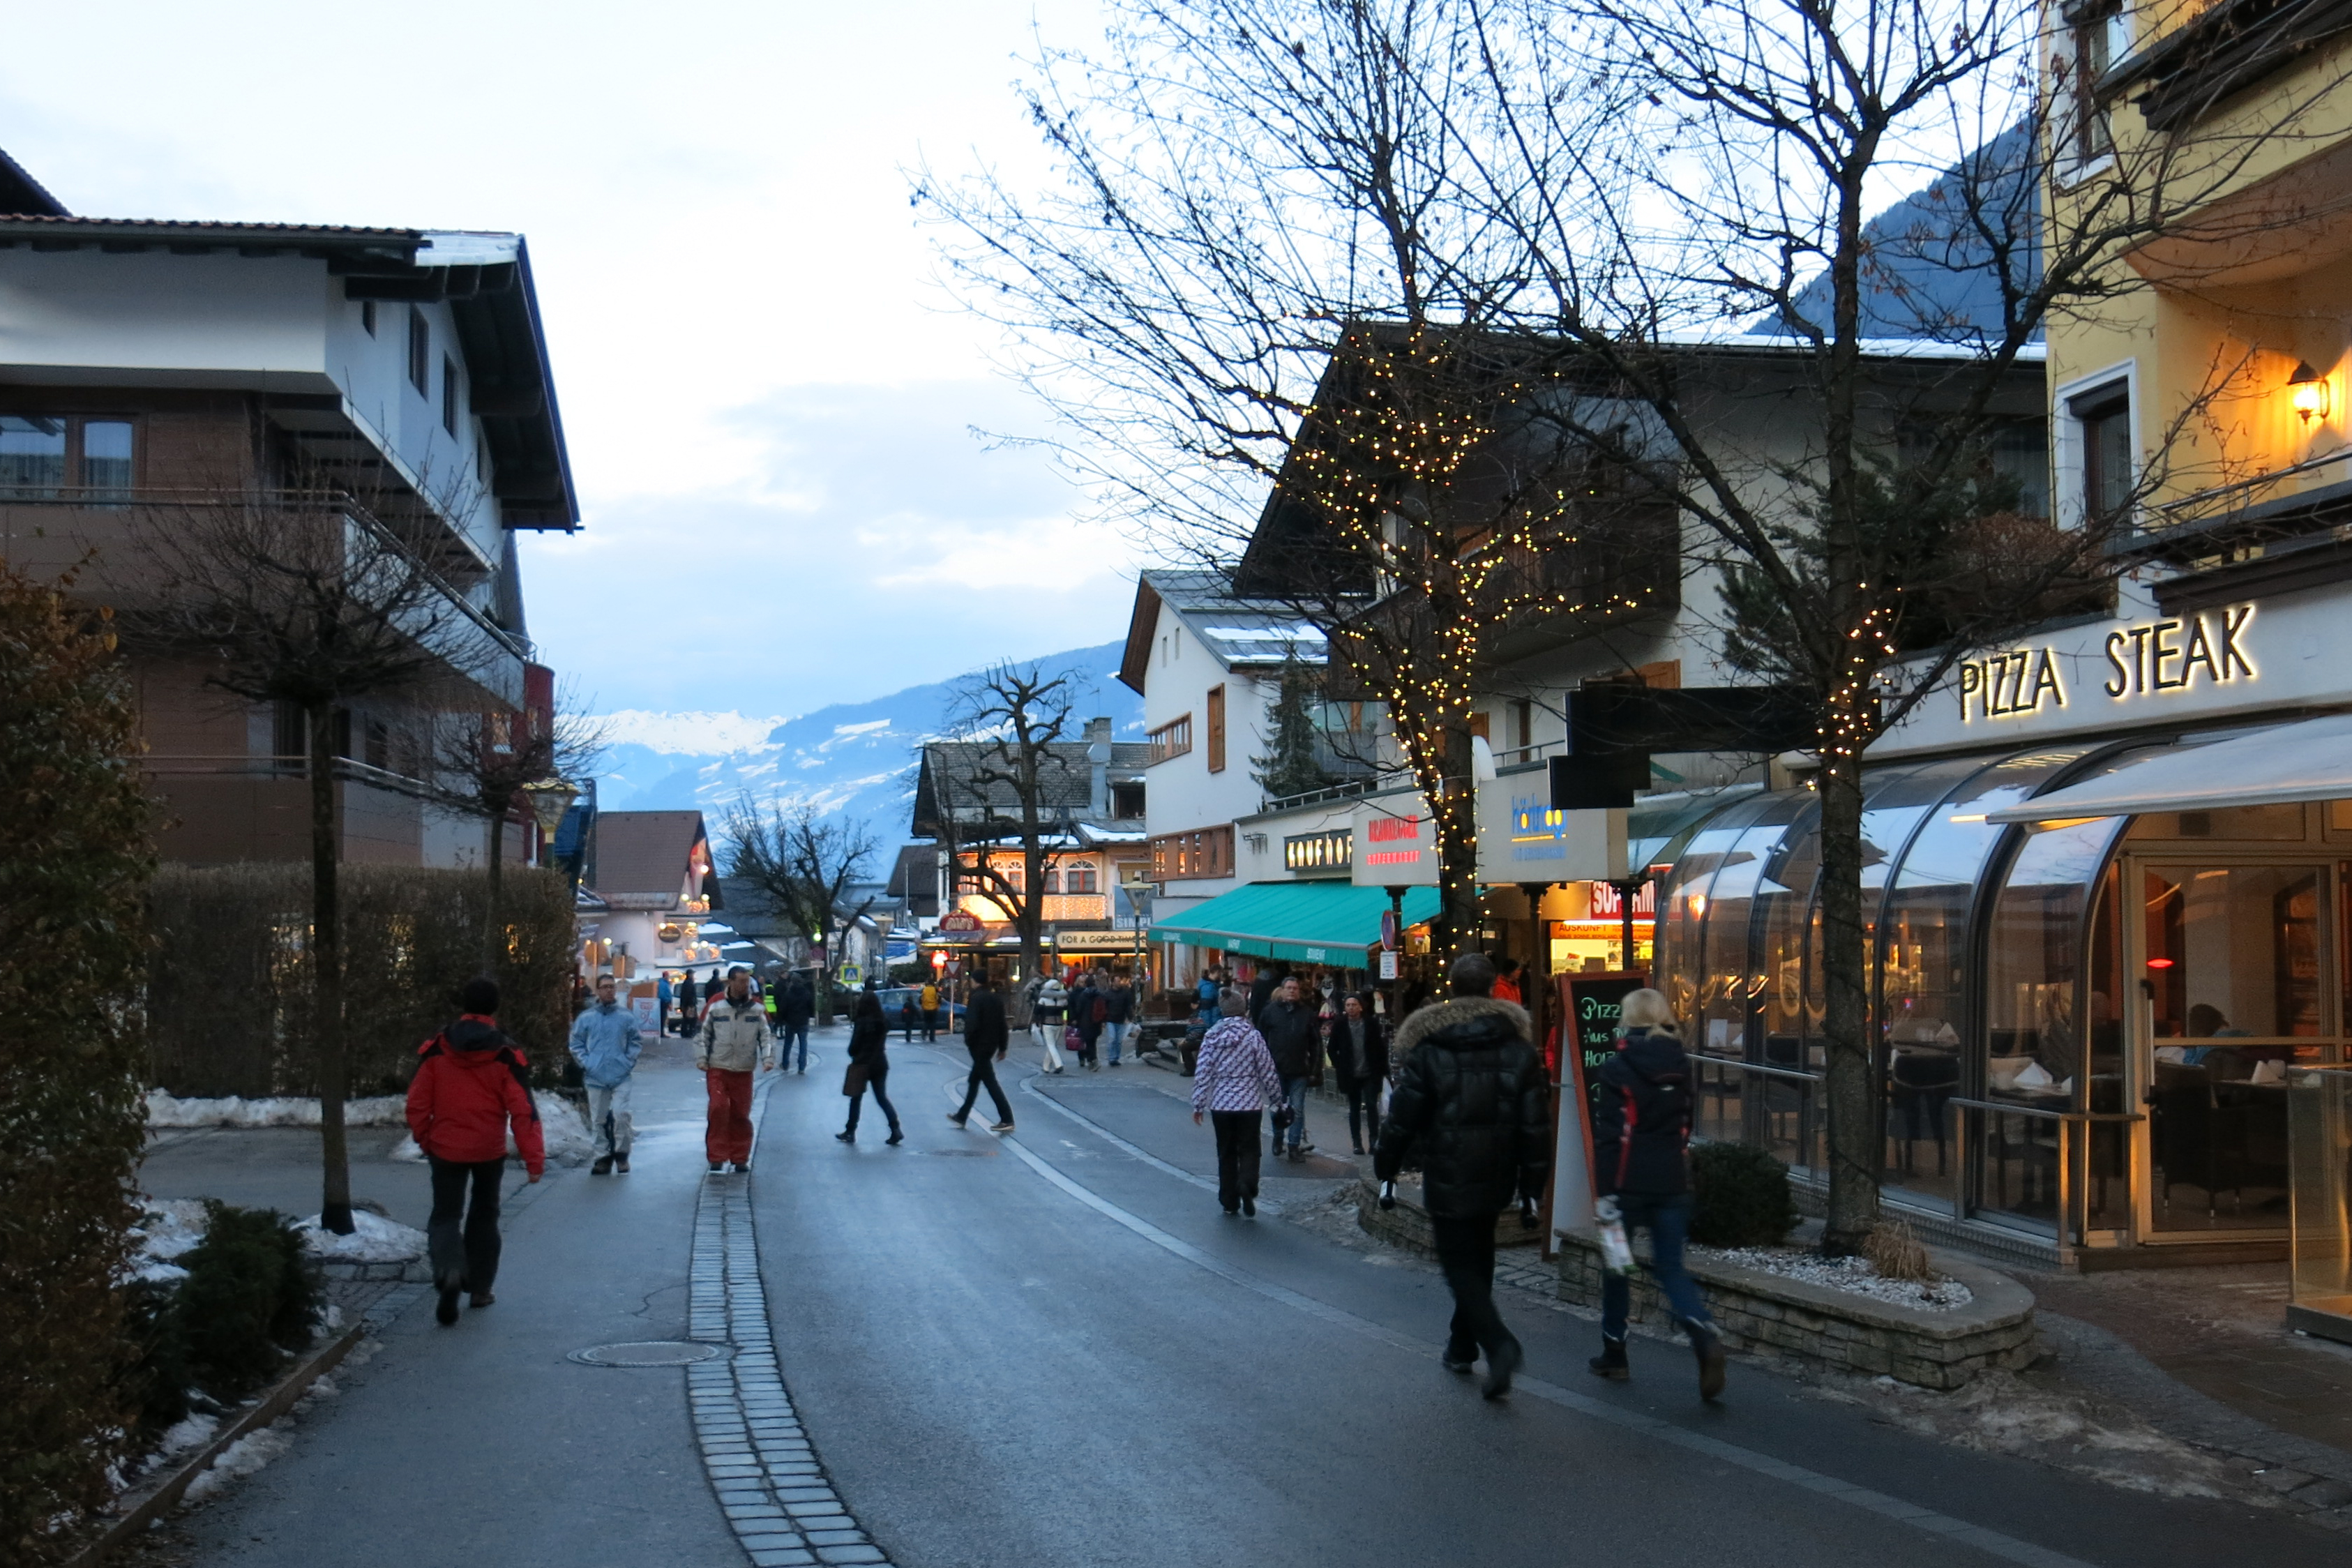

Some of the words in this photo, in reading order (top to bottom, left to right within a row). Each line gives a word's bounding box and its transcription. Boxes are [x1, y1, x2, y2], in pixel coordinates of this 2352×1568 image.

[1959, 647, 2067, 723] PIZZA
[2104, 604, 2259, 702] STEAK
[1367, 850, 1421, 866] SUPERMARKT
[1581, 997, 1622, 1020] PIZZ
